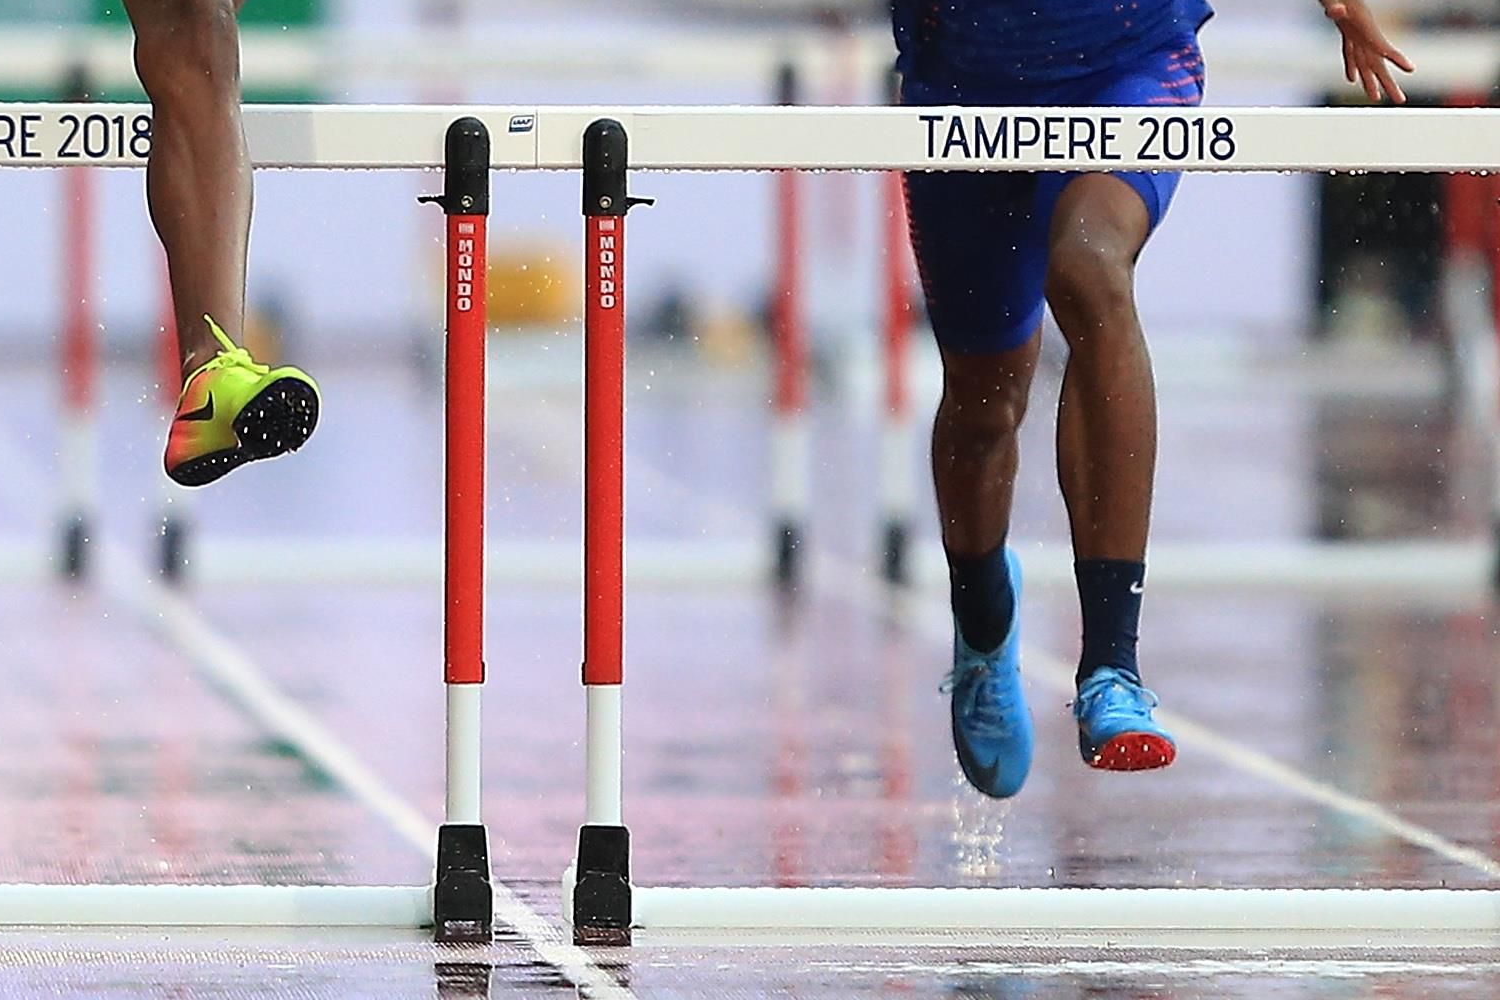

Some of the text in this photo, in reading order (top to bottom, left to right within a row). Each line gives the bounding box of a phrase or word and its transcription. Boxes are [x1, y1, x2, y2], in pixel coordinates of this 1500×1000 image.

[57, 114, 151, 159] 2018
[919, 115, 1236, 161] TAMPERE 2018
[456, 238, 473, 311] MONDO
[600, 235, 615, 309] MONDO
